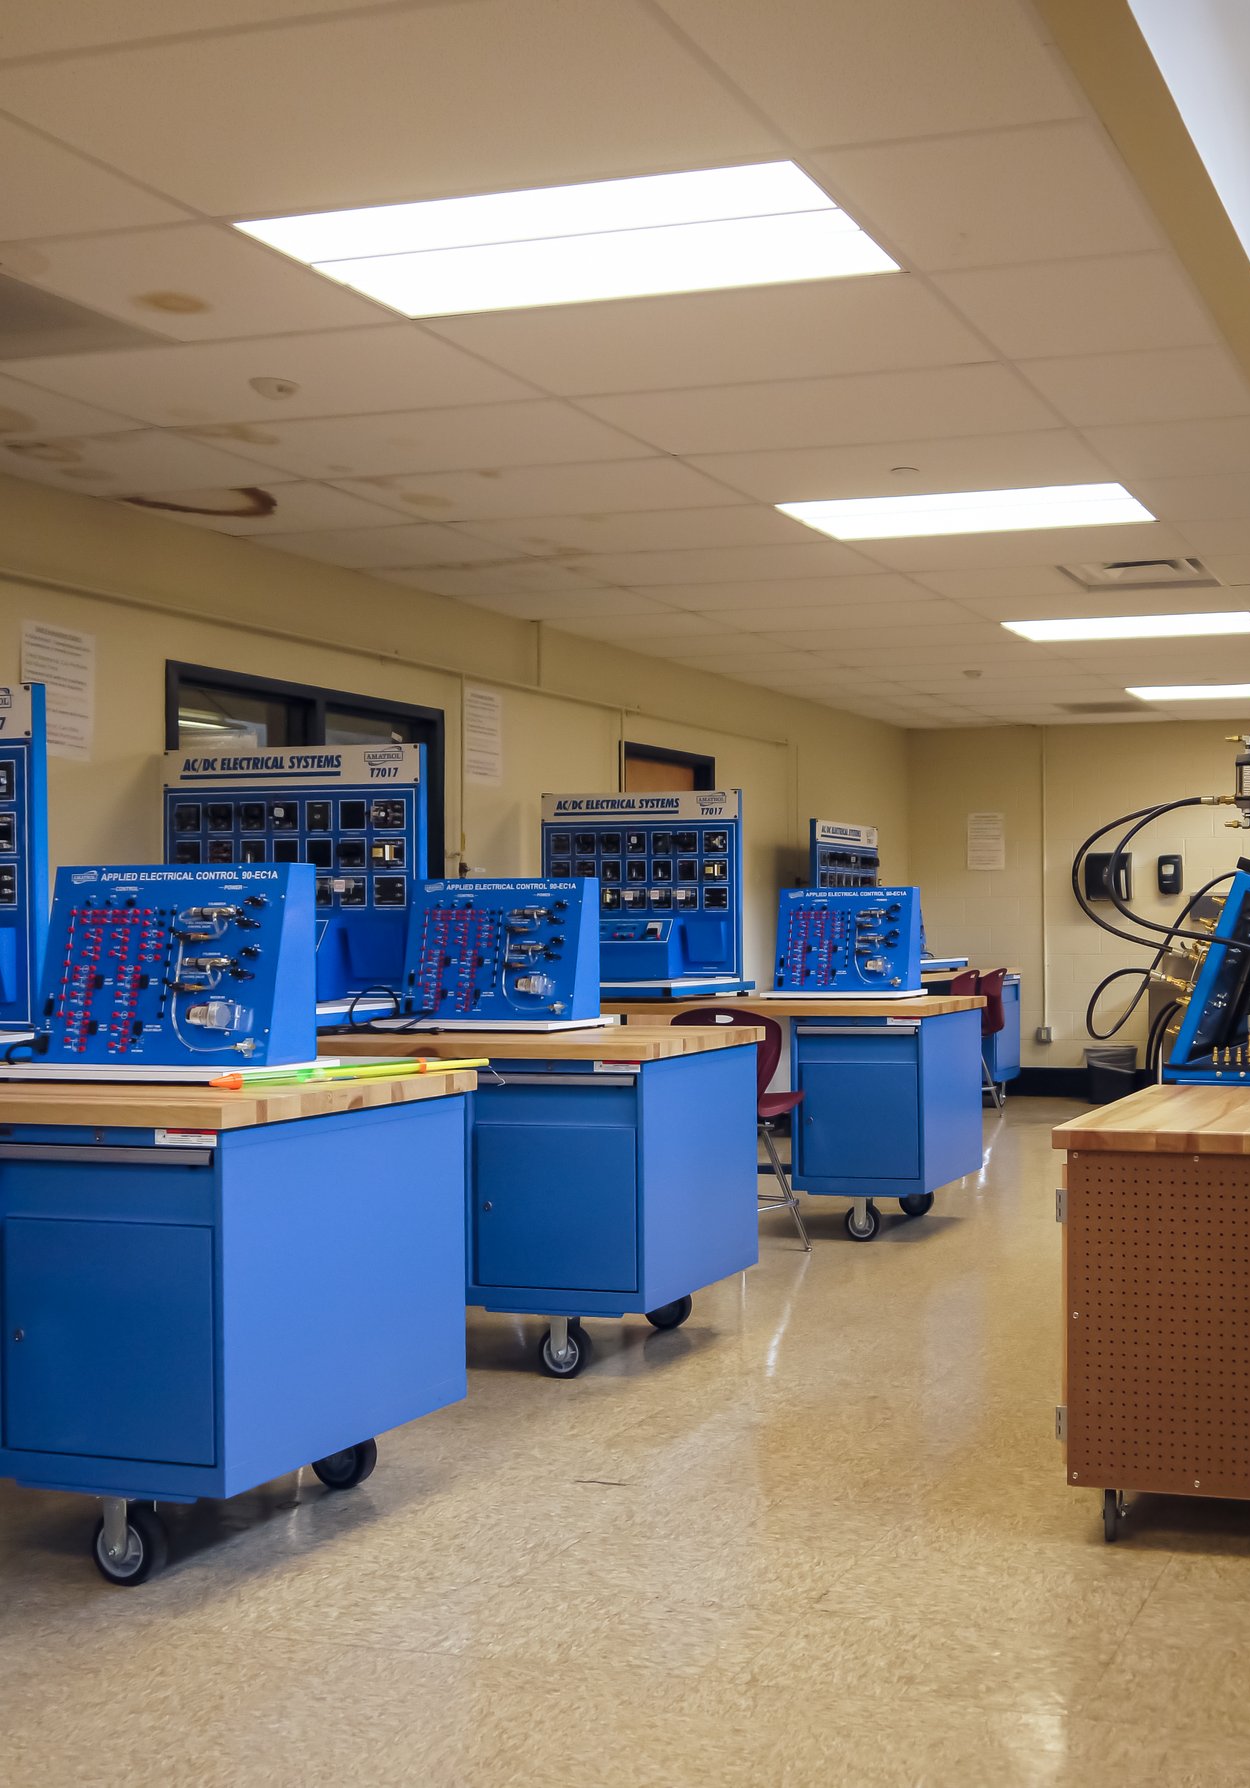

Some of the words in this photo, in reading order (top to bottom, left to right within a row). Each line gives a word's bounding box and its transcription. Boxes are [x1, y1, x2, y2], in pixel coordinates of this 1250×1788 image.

[182, 758, 217, 772] AC/DC
[220, 756, 285, 771] ELECTRICAL
[288, 754, 342, 769] SYSTEMS
[370, 767, 398, 778] T7017
[556, 800, 583, 811] AC/DC
[586, 799, 635, 810] ELECTRICAL
[639, 798, 680, 809] SYSTEMS
[701, 807, 723, 815] T7017
[101, 872, 138, 881] APPLIED
[139, 872, 194, 881] ELECTRICAL
[196, 871, 239, 880] CONTROL
[241, 871, 279, 880] 90-EC1A
[446, 883, 474, 891] APPLIED
[549, 882, 577, 890] 90-EC1A
